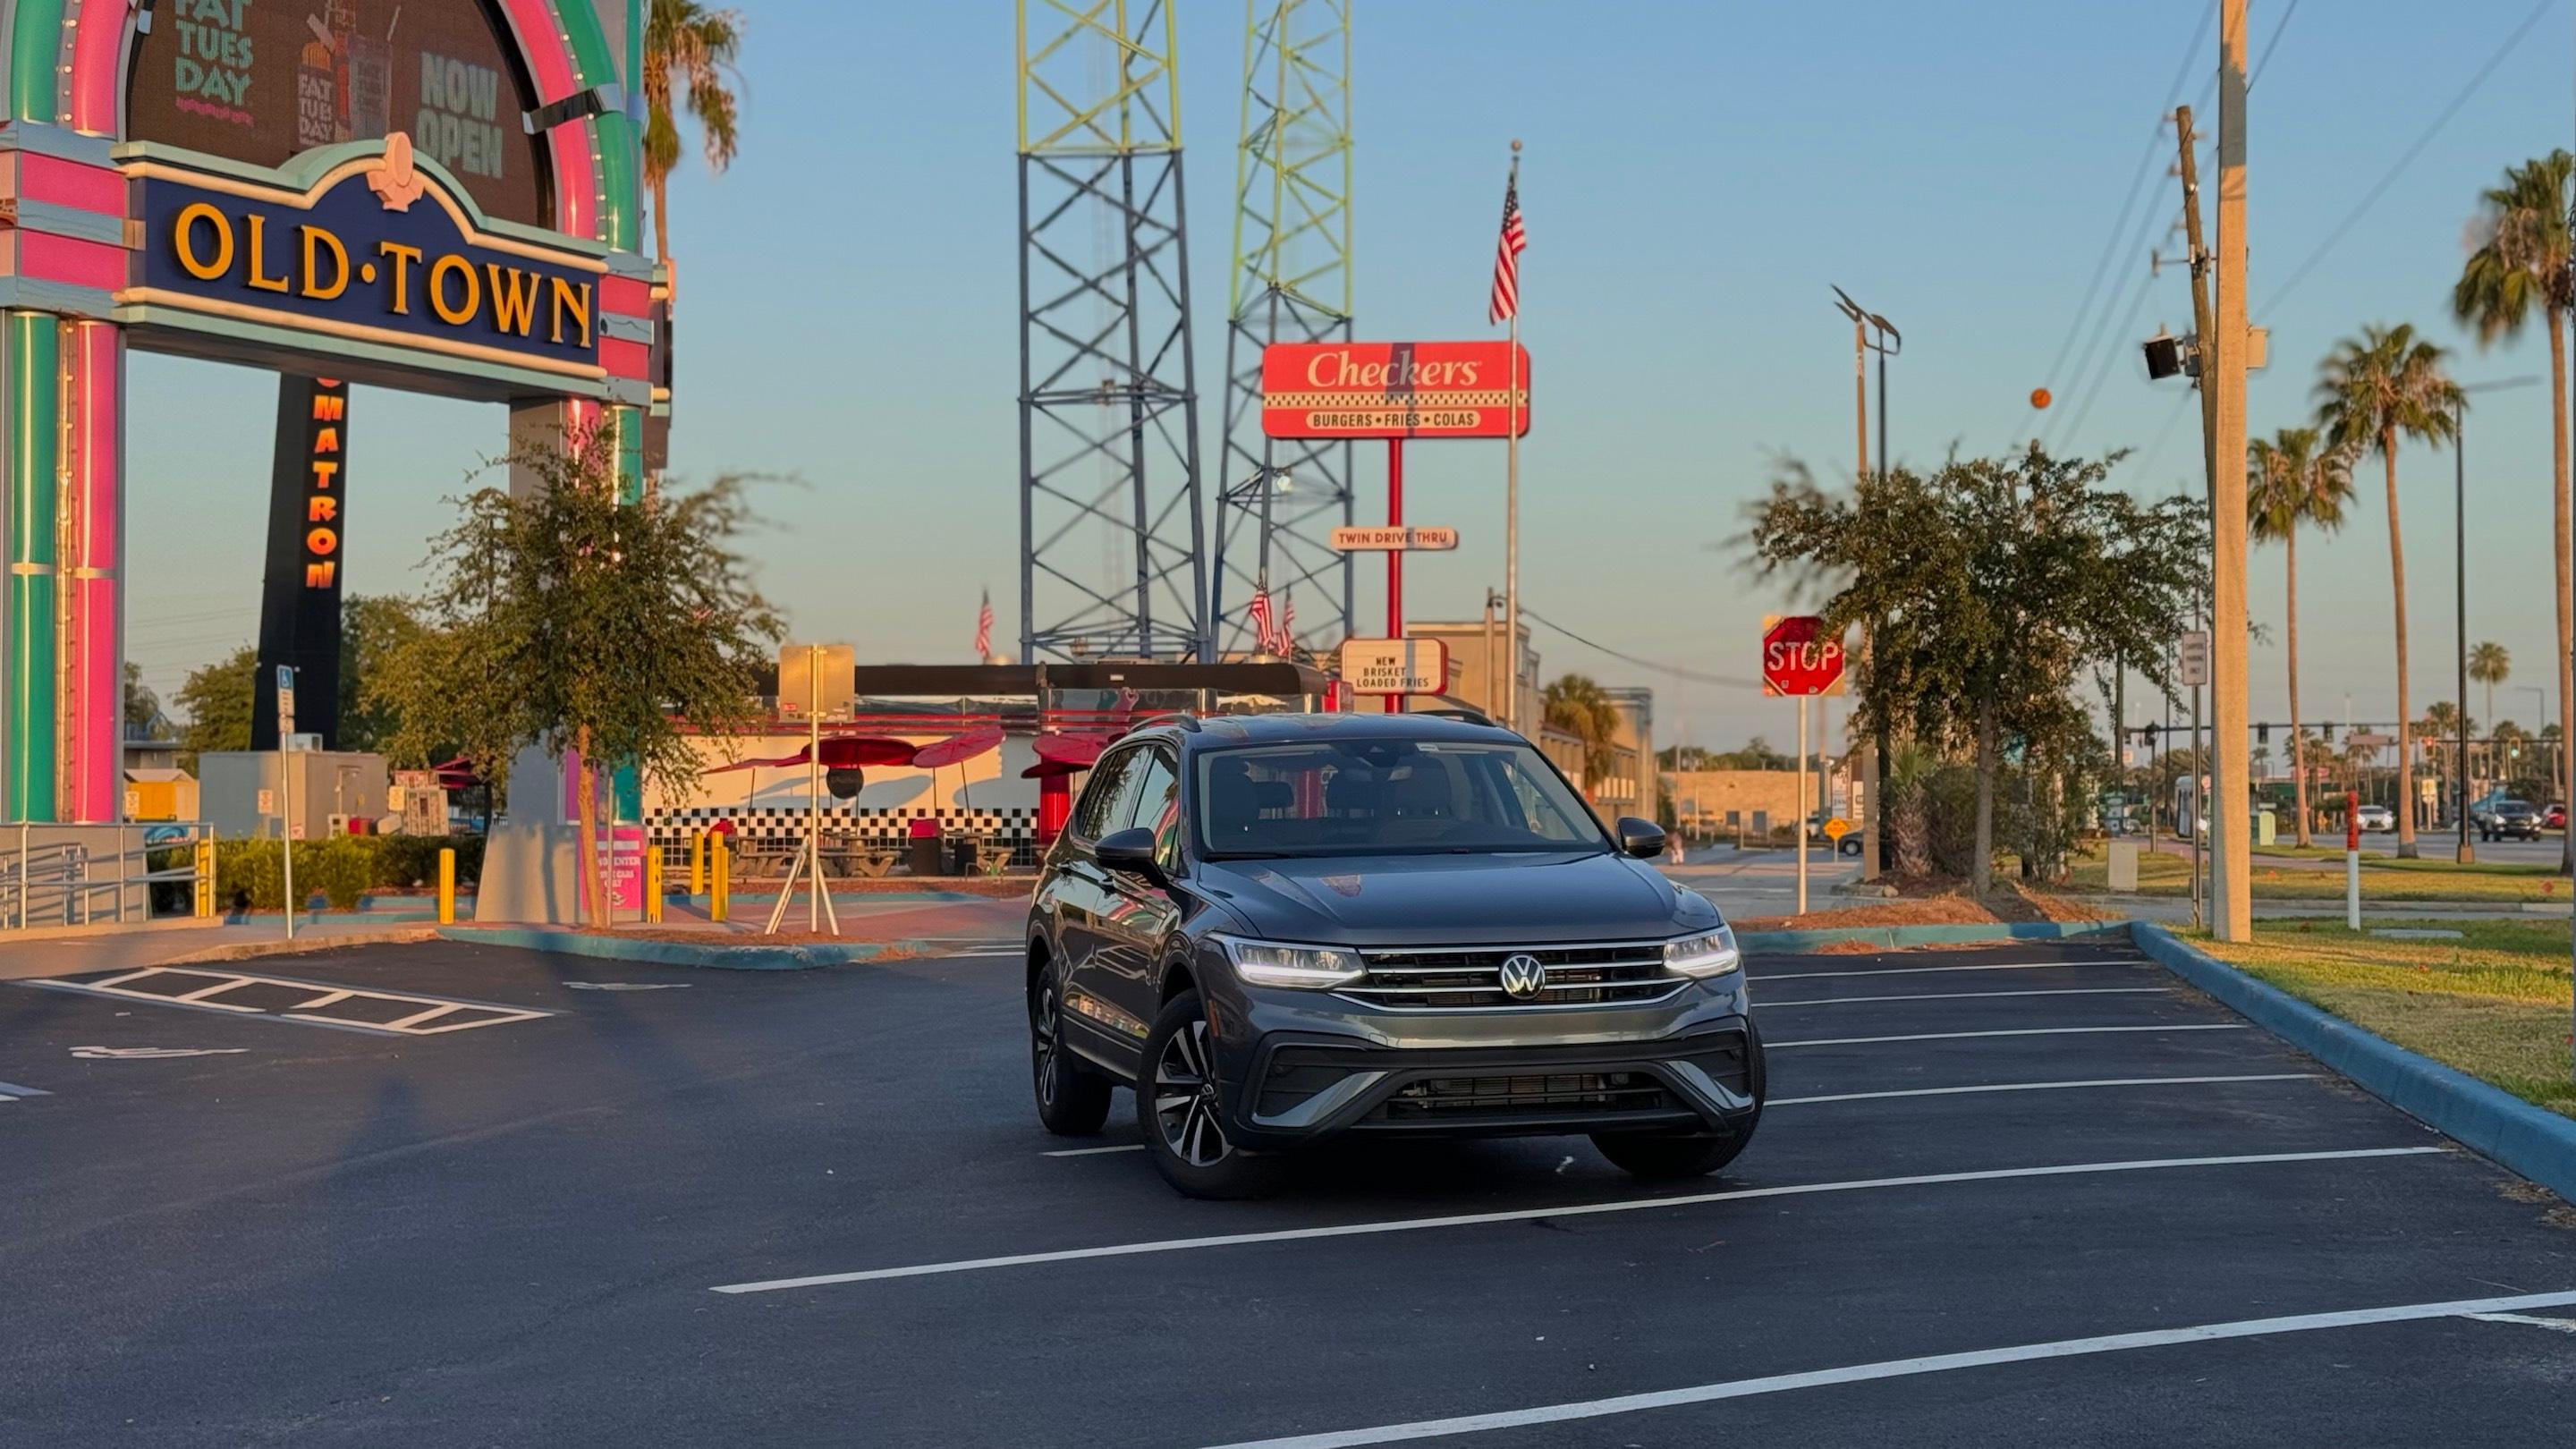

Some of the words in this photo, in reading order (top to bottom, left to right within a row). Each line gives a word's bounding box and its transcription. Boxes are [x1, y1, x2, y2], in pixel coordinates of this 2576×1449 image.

[175, 19, 254, 69] TUES
[175, 56, 253, 106] DAY
[298, 73, 332, 103] FAT
[420, 51, 498, 122] NOW
[416, 108, 503, 179] OPEN
[174, 202, 350, 301] OLD
[379, 241, 592, 349] TOWN
[1307, 350, 1479, 387] Checkers
[1312, 413, 1373, 427] BURGERS
[1385, 412, 1420, 426] FRIES
[1433, 412, 1475, 426] COLAS
[1339, 532, 1370, 544] TWIN
[1375, 532, 1412, 543] DRIVE
[1416, 531, 1448, 543] THRU
[1363, 667, 1407, 677] BRISKET
[1376, 657, 1396, 666] NEW
[1767, 640, 1839, 672] STOP
[1356, 678, 1397, 688] LOADED
[1400, 677, 1429, 688] FRIES
[1503, 955, 1545, 998] VW
